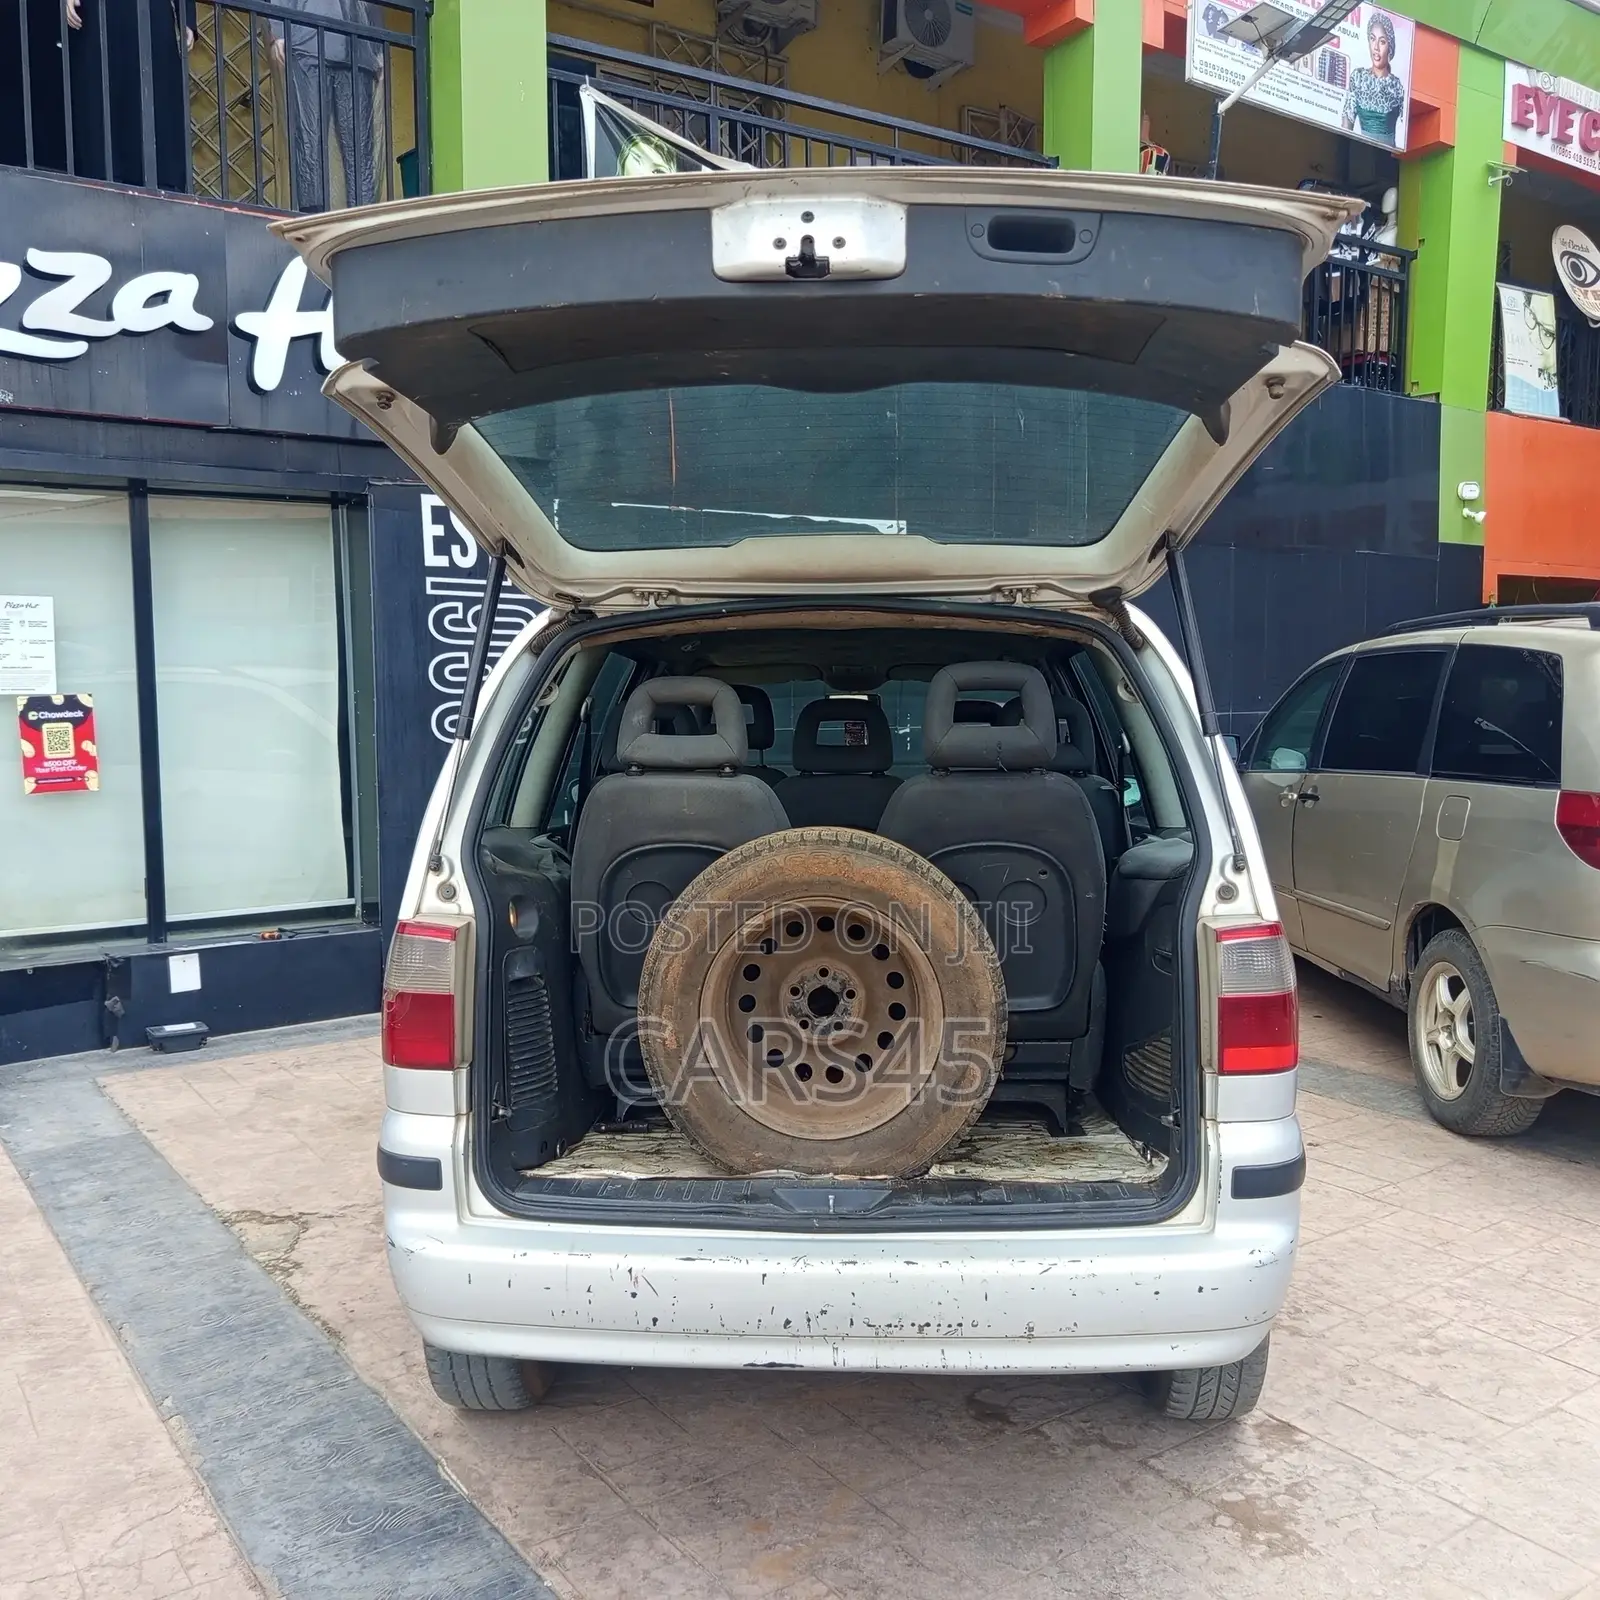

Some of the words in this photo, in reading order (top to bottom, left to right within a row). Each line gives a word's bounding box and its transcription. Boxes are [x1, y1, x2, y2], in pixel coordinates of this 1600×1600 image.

[1511, 83, 1577, 144] EYE
[4, 601, 24, 609] Pizza
[38, 710, 84, 719] Chowdeck
